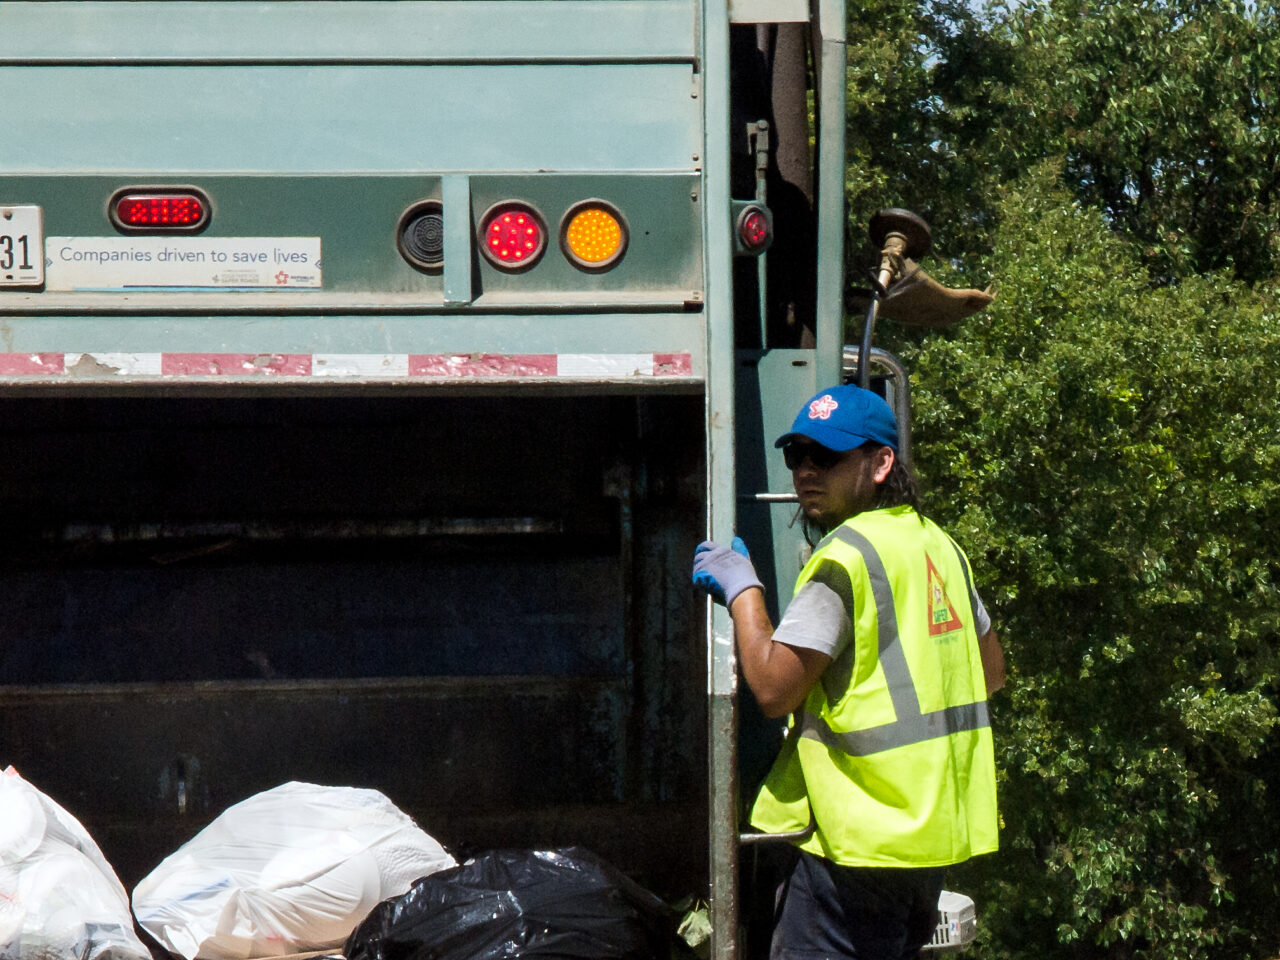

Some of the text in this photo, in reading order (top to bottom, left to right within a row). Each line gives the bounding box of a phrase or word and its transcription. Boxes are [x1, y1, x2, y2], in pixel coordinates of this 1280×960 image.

[60, 246, 308, 265] Companies driven to save lives
